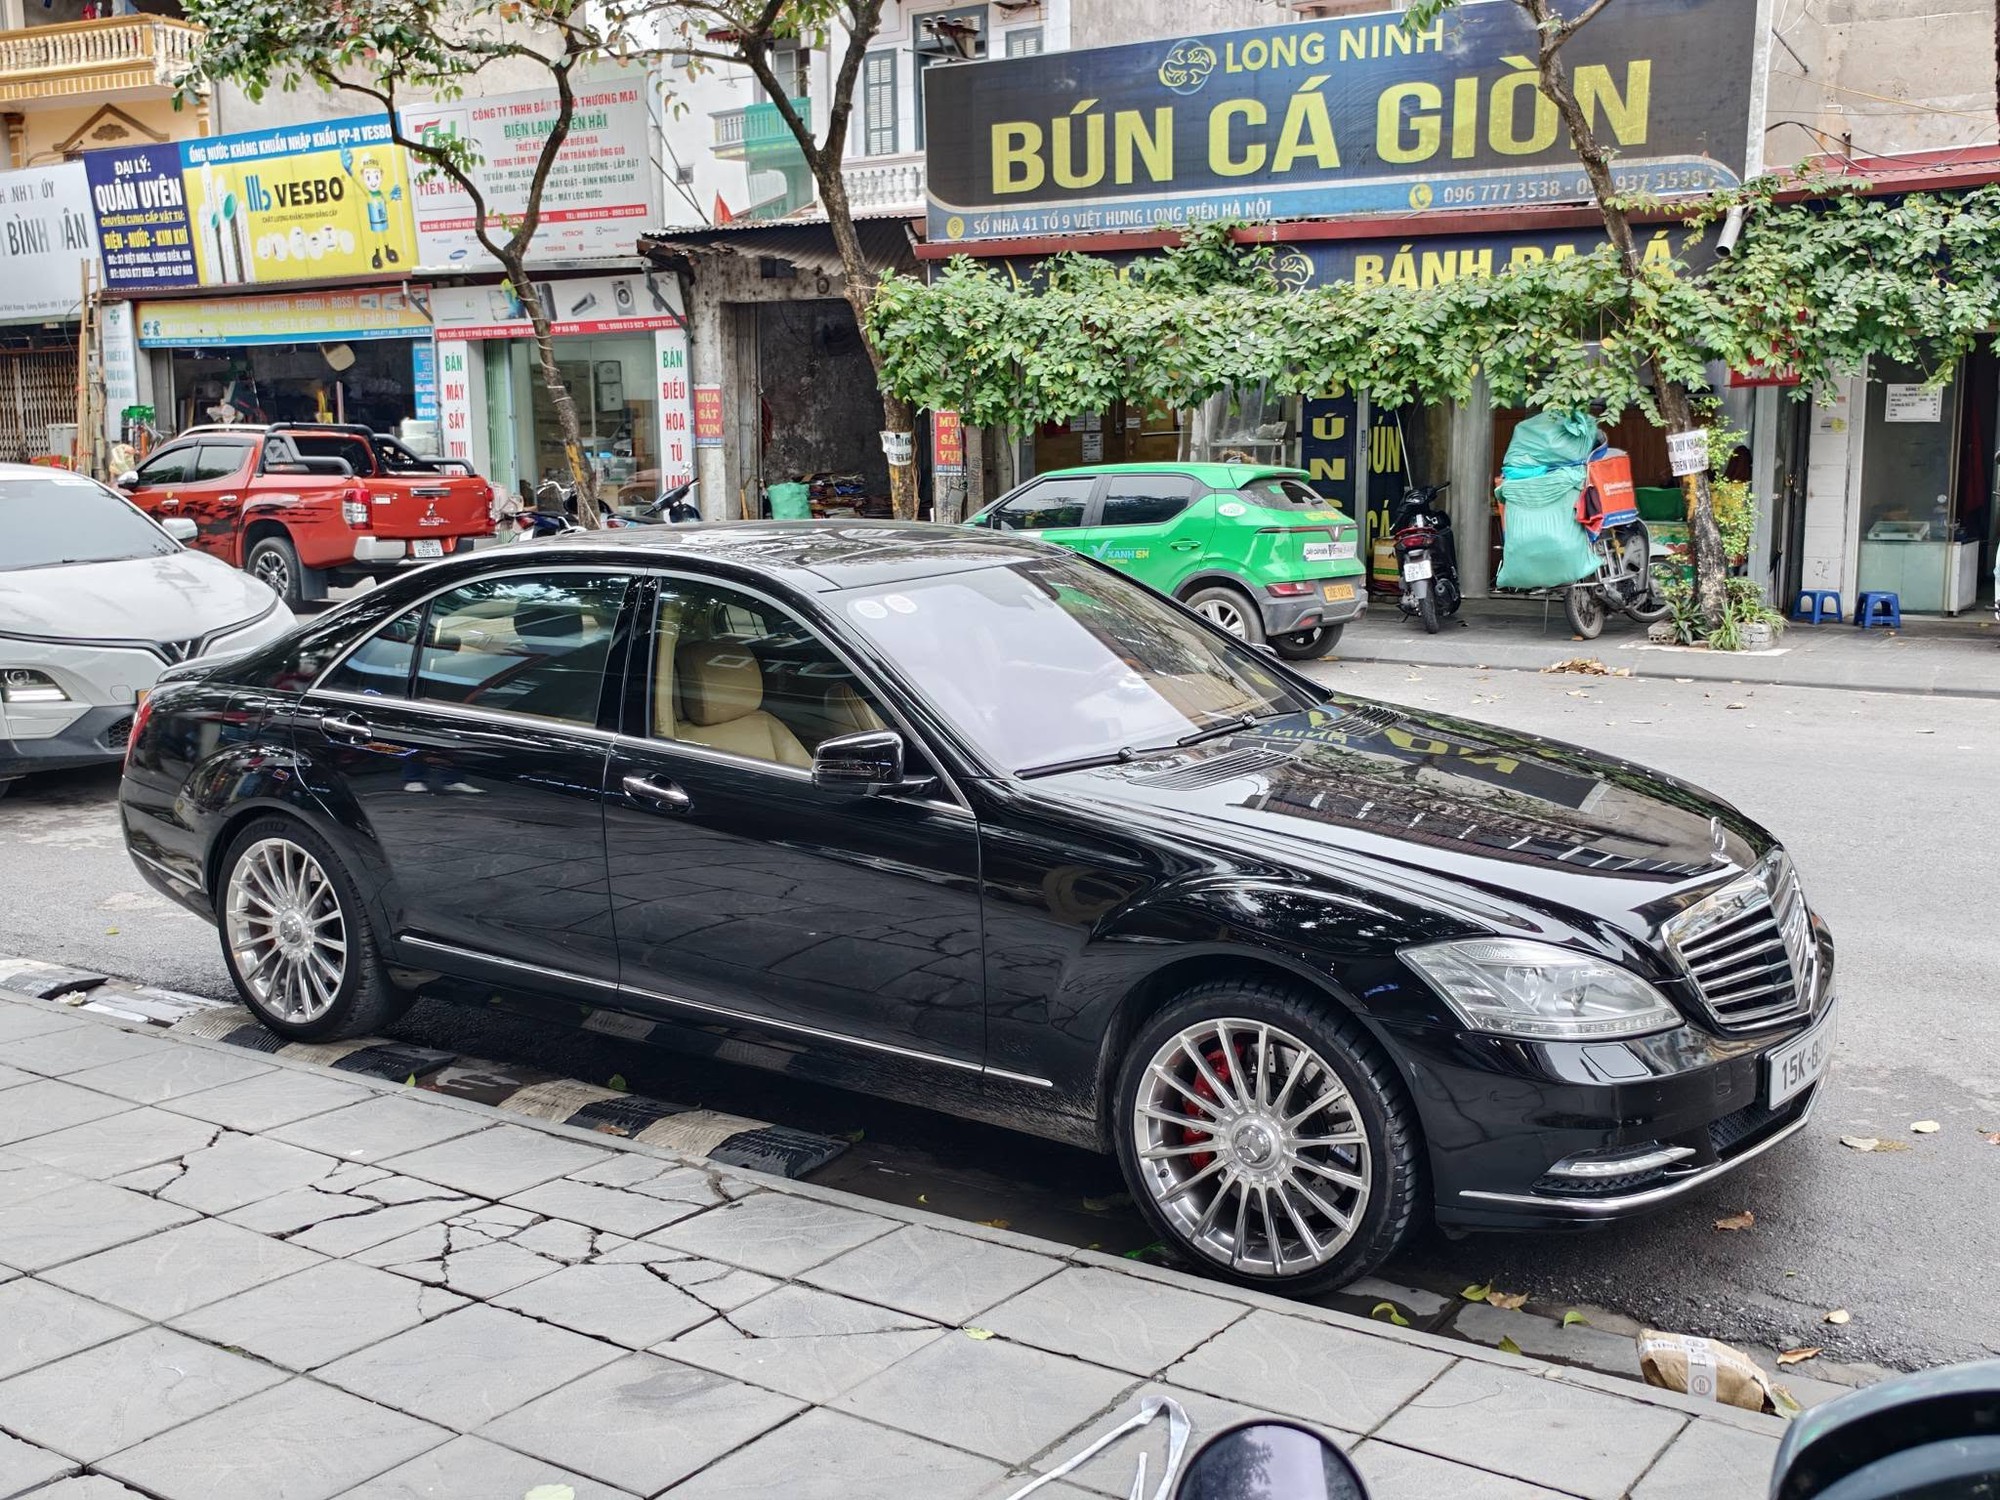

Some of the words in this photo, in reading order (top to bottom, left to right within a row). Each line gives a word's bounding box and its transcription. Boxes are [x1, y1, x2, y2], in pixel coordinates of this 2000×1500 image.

[1225, 32, 1325, 74] LONG
[1339, 18, 1444, 62] NINH
[472, 107, 496, 121] CÔNG
[497, 106, 508, 117] TY
[509, 104, 533, 115] TNHH
[581, 94, 618, 107] THƯƠNG
[620, 90, 638, 105] MẠI
[504, 119, 529, 141] ĐIỆN
[991, 98, 1174, 195] BÚN
[1209, 75, 1341, 177] CÁ
[1376, 54, 1652, 165] GIÒN
[189, 144, 207, 163] ỐNG
[207, 141, 230, 162] NƯỚC
[230, 139, 259, 157] KHÁNG
[259, 132, 288, 156] KHUẨN
[289, 132, 312, 154] NHẬP
[313, 125, 338, 148] KHẨU
[338, 129, 361, 149] PP-R
[362, 124, 393, 141] VESBO
[114, 159, 133, 179] ĐẠI
[135, 154, 152, 174] LÝ:
[95, 178, 139, 214] QUÂN
[139, 173, 183, 208] UYÊN
[274, 176, 345, 208] VESBO
[1444, 185, 1476, 204] 096
[1479, 183, 1511, 202] 777
[1516, 180, 1560, 199] 3538
[1576, 178, 1599, 196] 09
[1615, 174, 1649, 193] 937
[1655, 169, 1702, 191] 3538
[101, 213, 127, 227] CHUYÊN
[127, 213, 145, 225] CUNG
[145, 210, 158, 223] CẤP
[974, 214, 990, 235] SỐ
[993, 214, 1020, 233] NHÀ
[1022, 217, 1039, 232] 41
[1042, 210, 1059, 230] TỔ
[1062, 214, 1071, 228] 9
[1073, 210, 1102, 230] VIỆT
[1105, 207, 1142, 226] HƯNG
[1147, 206, 1183, 224] LONG
[1186, 201, 1218, 220] BIÊN
[1222, 199, 1241, 217] HÀ
[1245, 197, 1272, 218] NỘI
[7, 213, 51, 256] BÌNH
[59, 207, 89, 251] ÂN
[103, 230, 123, 252] ĐIỆN
[128, 226, 151, 248] NƯỚC
[156, 229, 173, 246] KIM
[174, 225, 189, 245] KHÍ
[562, 229, 584, 238] HITACHI
[1354, 243, 1492, 294] BÁNH
[445, 351, 462, 372] BÁN
[662, 346, 683, 369] BÁN
[446, 379, 464, 401] MÁY
[663, 375, 685, 400] ĐIỀU
[697, 392, 720, 404] MUA
[449, 405, 466, 430] SẤY
[666, 409, 685, 431] HÒA
[699, 404, 719, 420] SẮT
[698, 422, 720, 436] VỤN
[450, 441, 467, 458] TIVI
[670, 437, 684, 462] TỦ
[1108, 549, 1135, 559] XANH
[1135, 549, 1150, 559] SM
